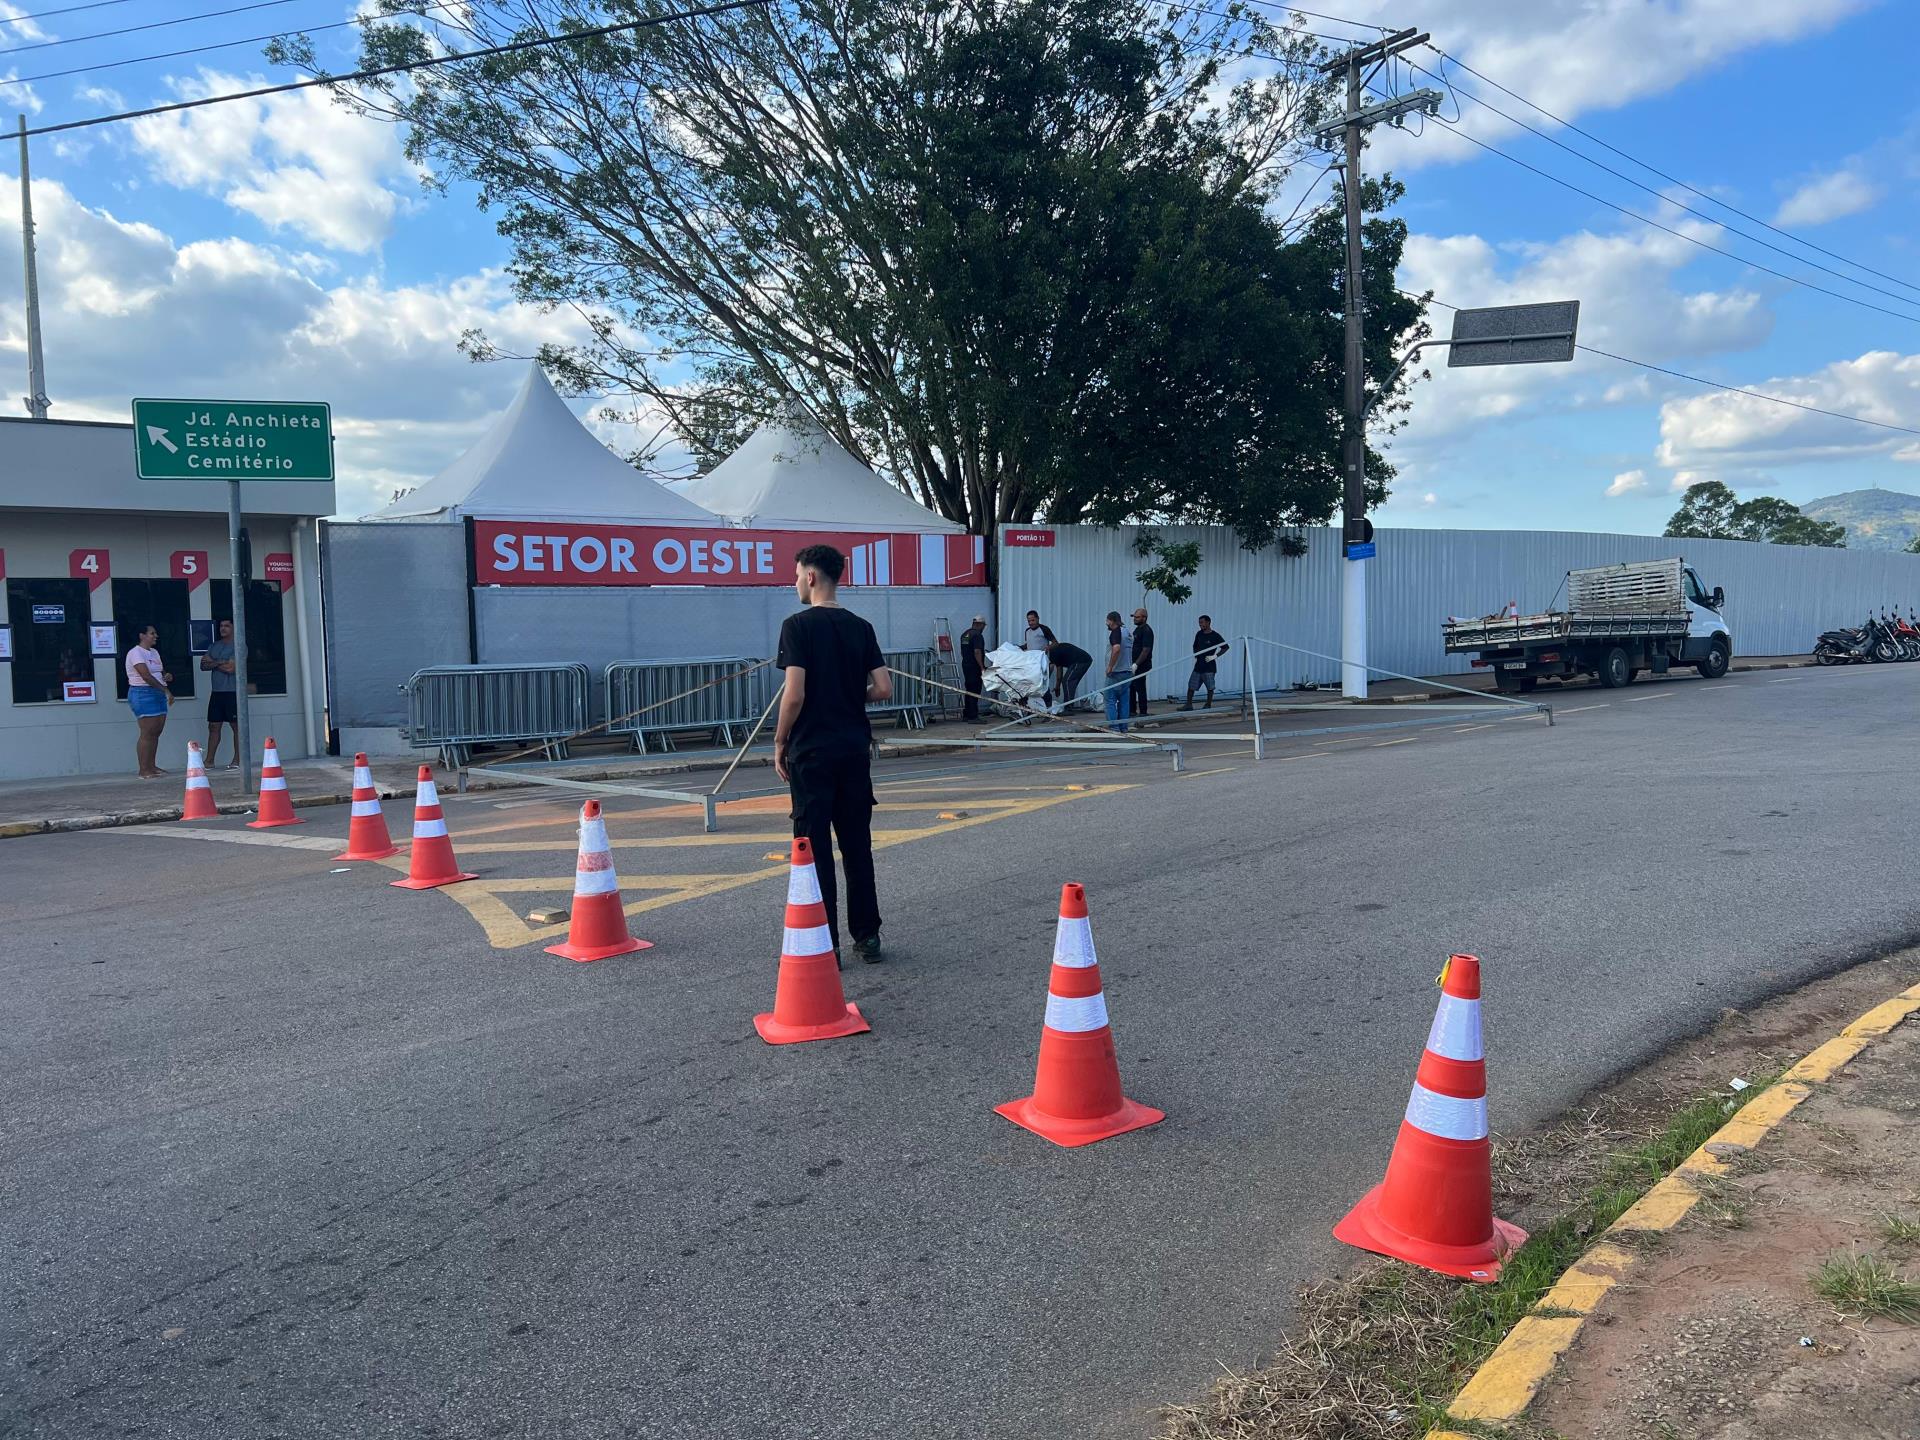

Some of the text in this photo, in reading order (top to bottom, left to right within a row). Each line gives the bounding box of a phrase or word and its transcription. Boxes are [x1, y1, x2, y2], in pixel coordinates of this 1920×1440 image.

[185, 412, 321, 429] Jd. Anchieta
[185, 431, 267, 448] Estádio
[187, 452, 293, 470] Cemitério
[493, 533, 774, 575] SETOR OESTE
[81, 554, 99, 573] 4
[182, 555, 197, 575] 5
